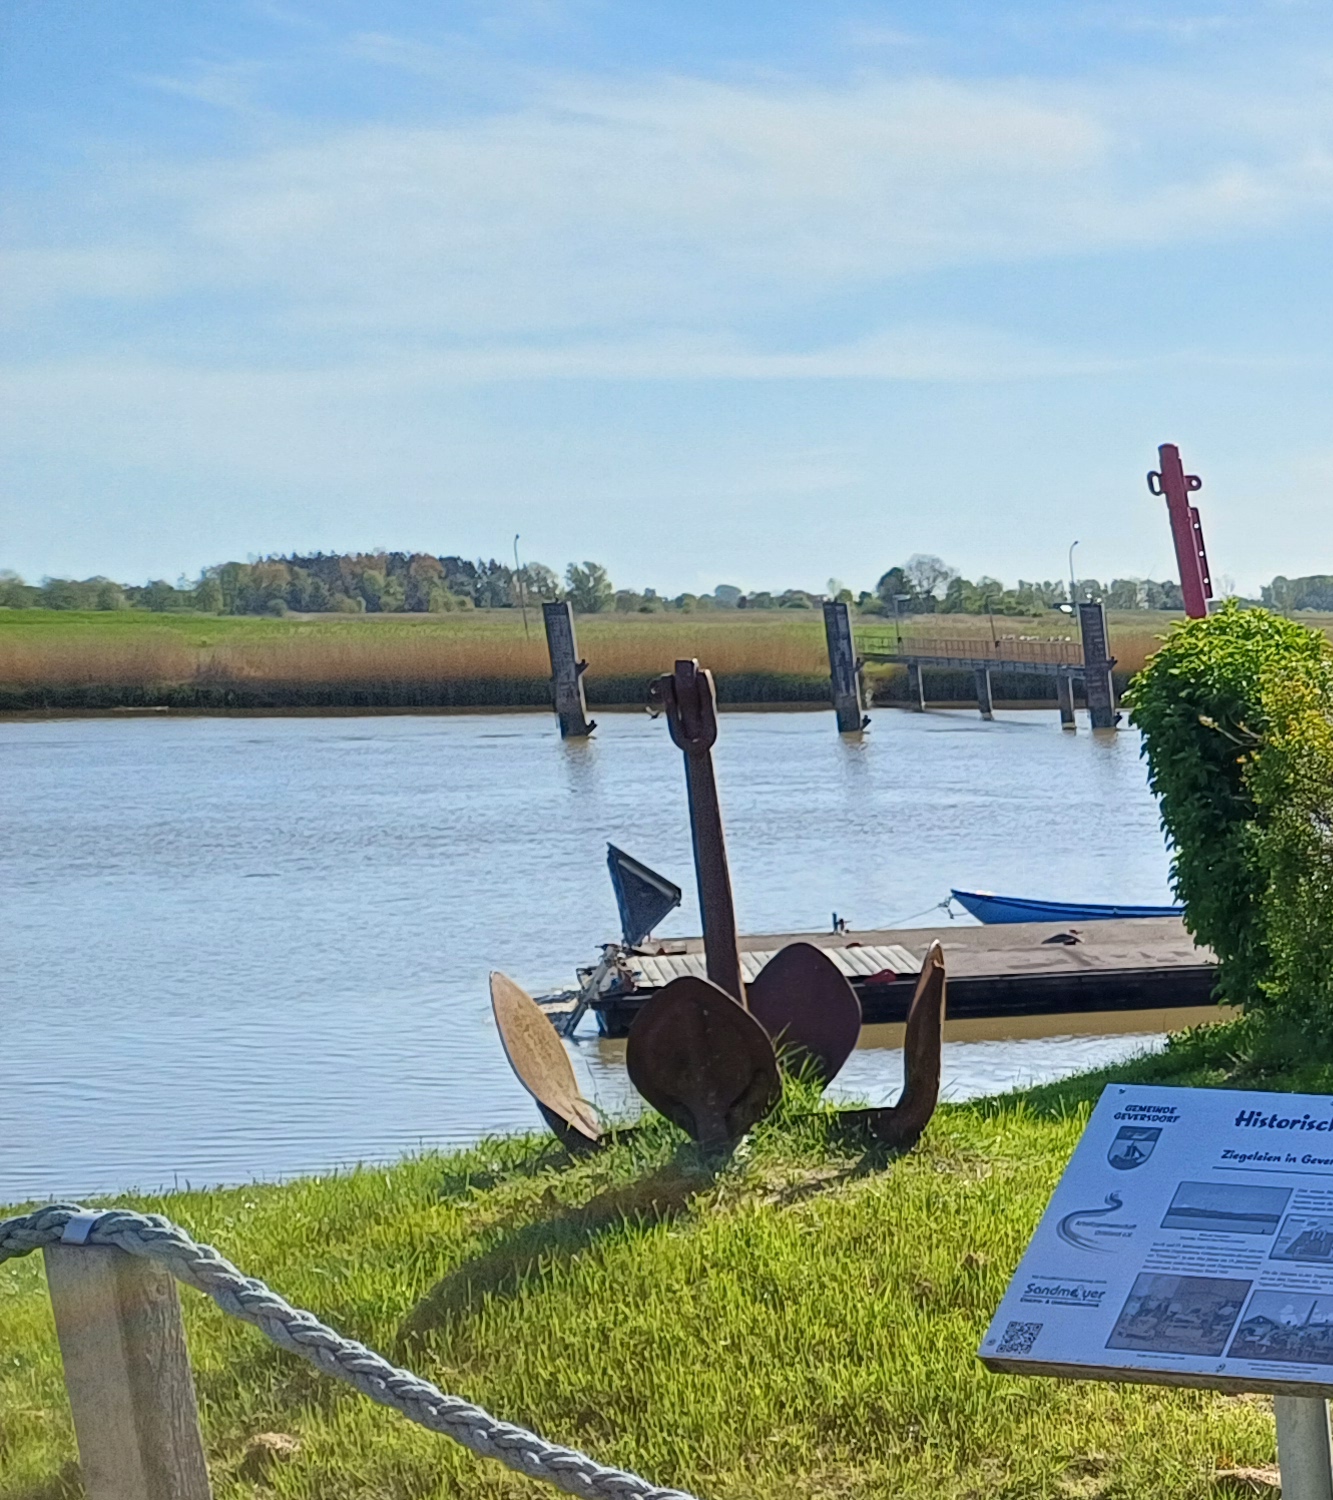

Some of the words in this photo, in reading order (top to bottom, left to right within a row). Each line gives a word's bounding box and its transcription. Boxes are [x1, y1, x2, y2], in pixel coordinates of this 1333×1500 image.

[1125, 1104, 1177, 1114] GEMEINDE
[1114, 1112, 1180, 1123] GEVERSDORF
[1221, 1149, 1281, 1163] Ziegeleien
[1285, 1153, 1297, 1163] in
